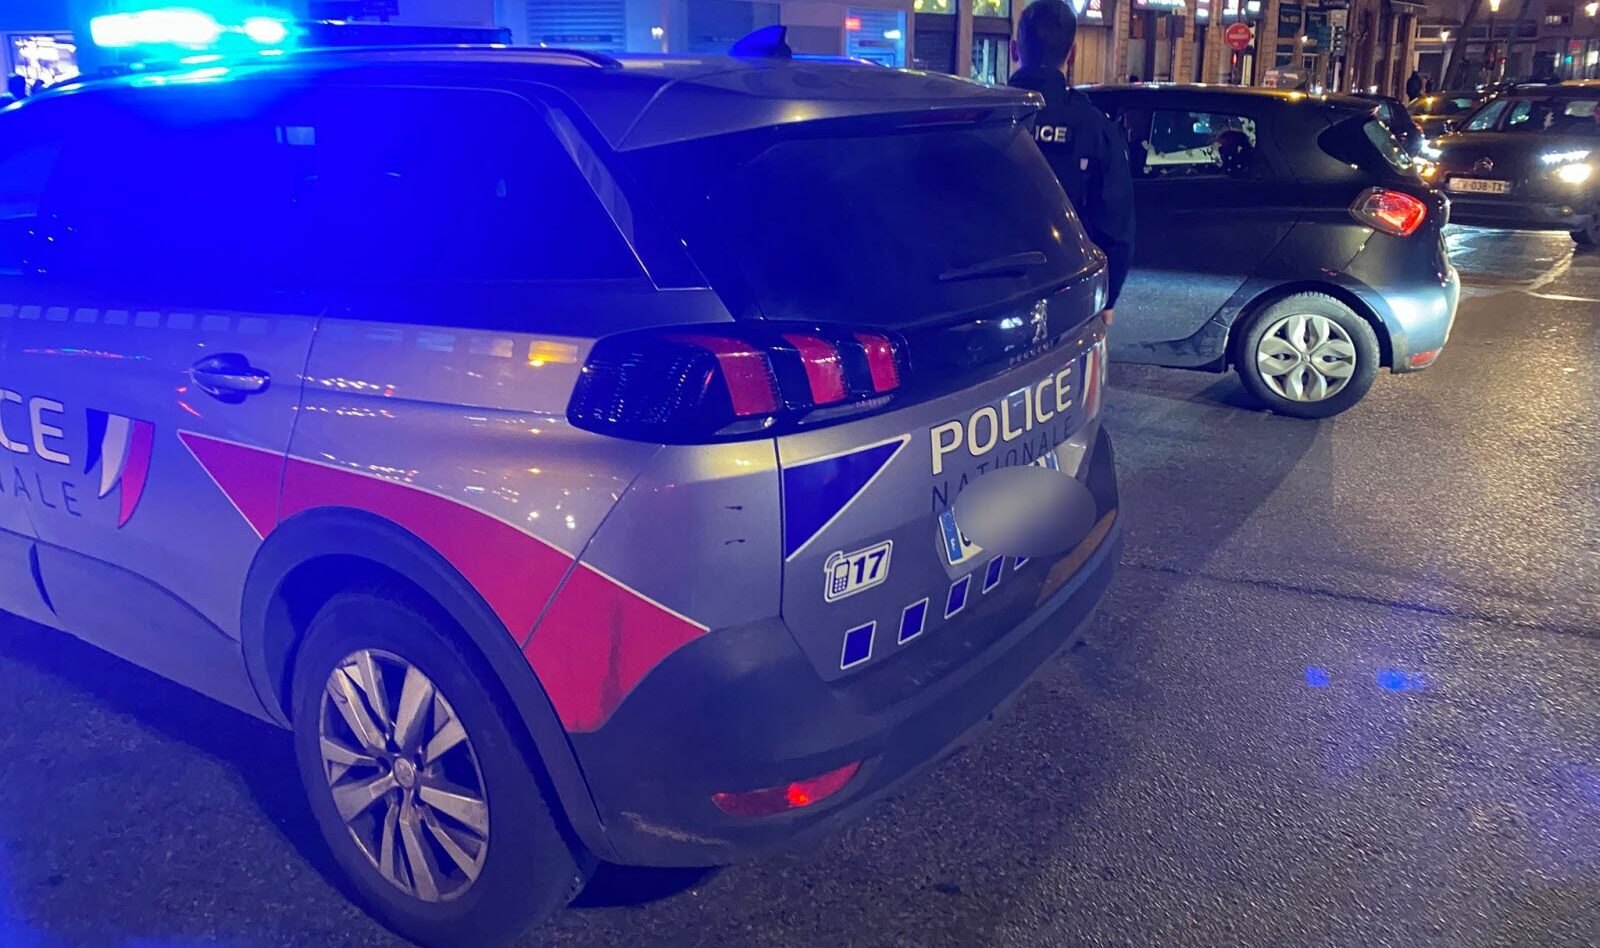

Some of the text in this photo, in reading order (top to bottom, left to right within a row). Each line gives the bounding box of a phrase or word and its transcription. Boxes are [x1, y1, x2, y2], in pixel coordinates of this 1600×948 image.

[929, 366, 1073, 477] POLICE
[0, 466, 82, 517] ALE
[853, 548, 887, 585] 17
